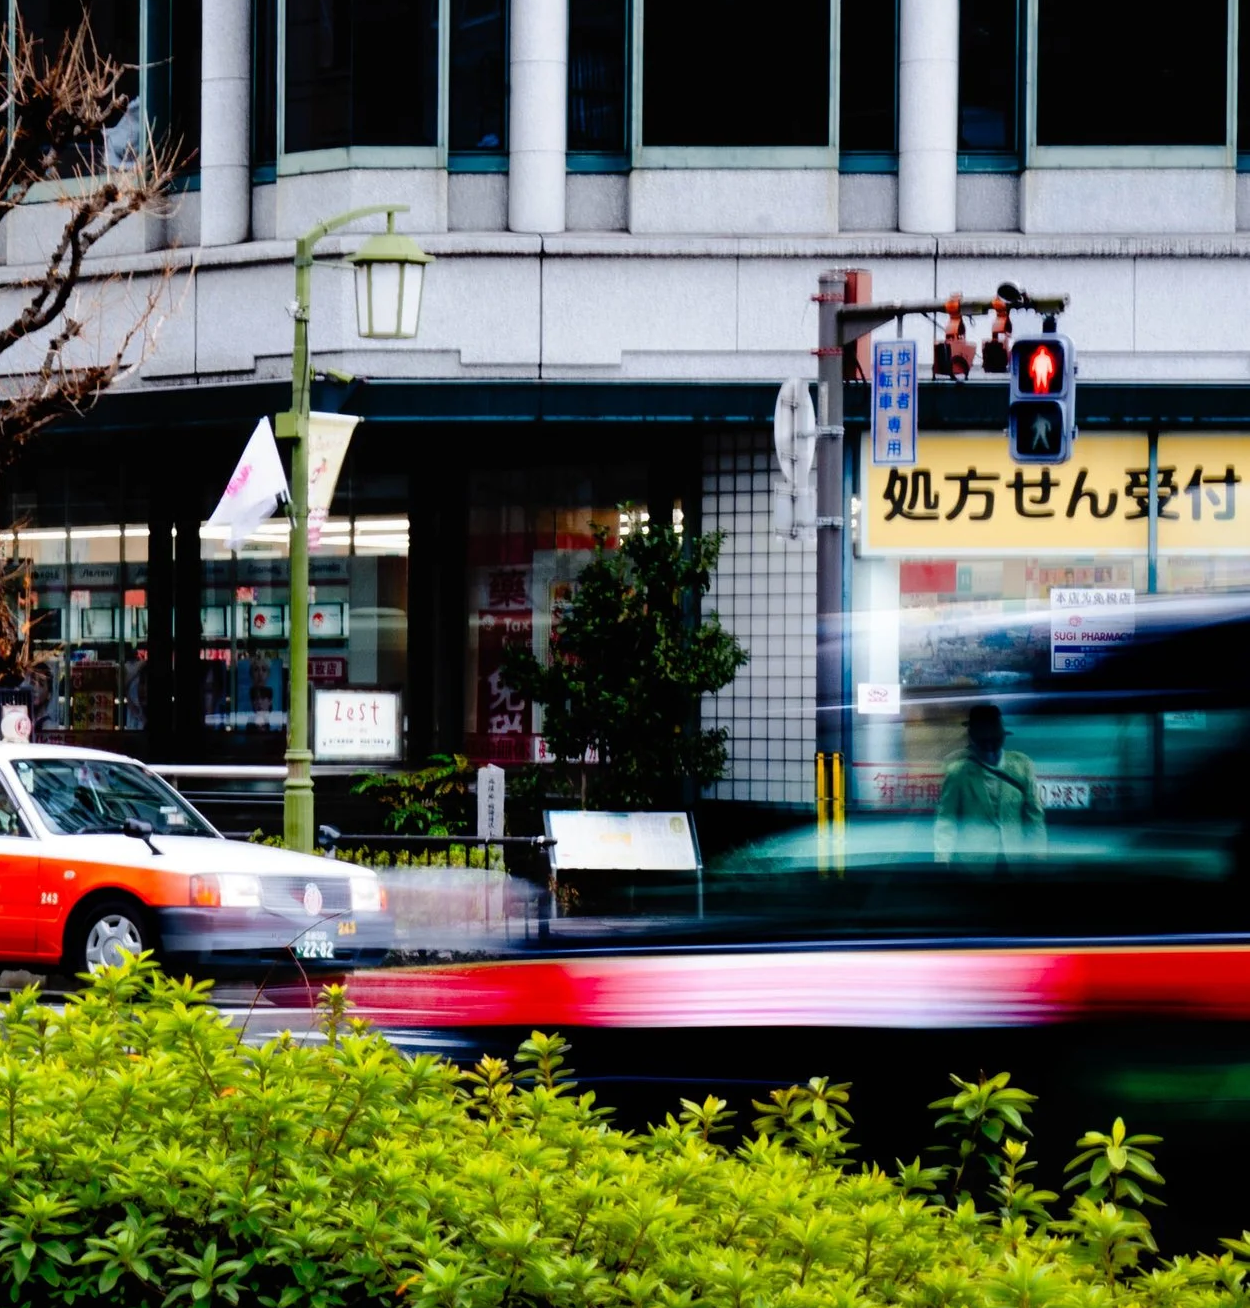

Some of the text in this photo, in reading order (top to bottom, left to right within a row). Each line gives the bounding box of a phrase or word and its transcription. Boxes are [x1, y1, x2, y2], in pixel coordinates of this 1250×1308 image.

[879, 350, 893, 409] 自転車
[897, 349, 910, 409] 歩行者
[888, 416, 901, 456] 専用
[883, 465, 1241, 522] 処方せん受付
[503, 617, 531, 632] Tax
[1054, 631, 1131, 641] SUGI PHARMACY
[41, 892, 58, 904] 243
